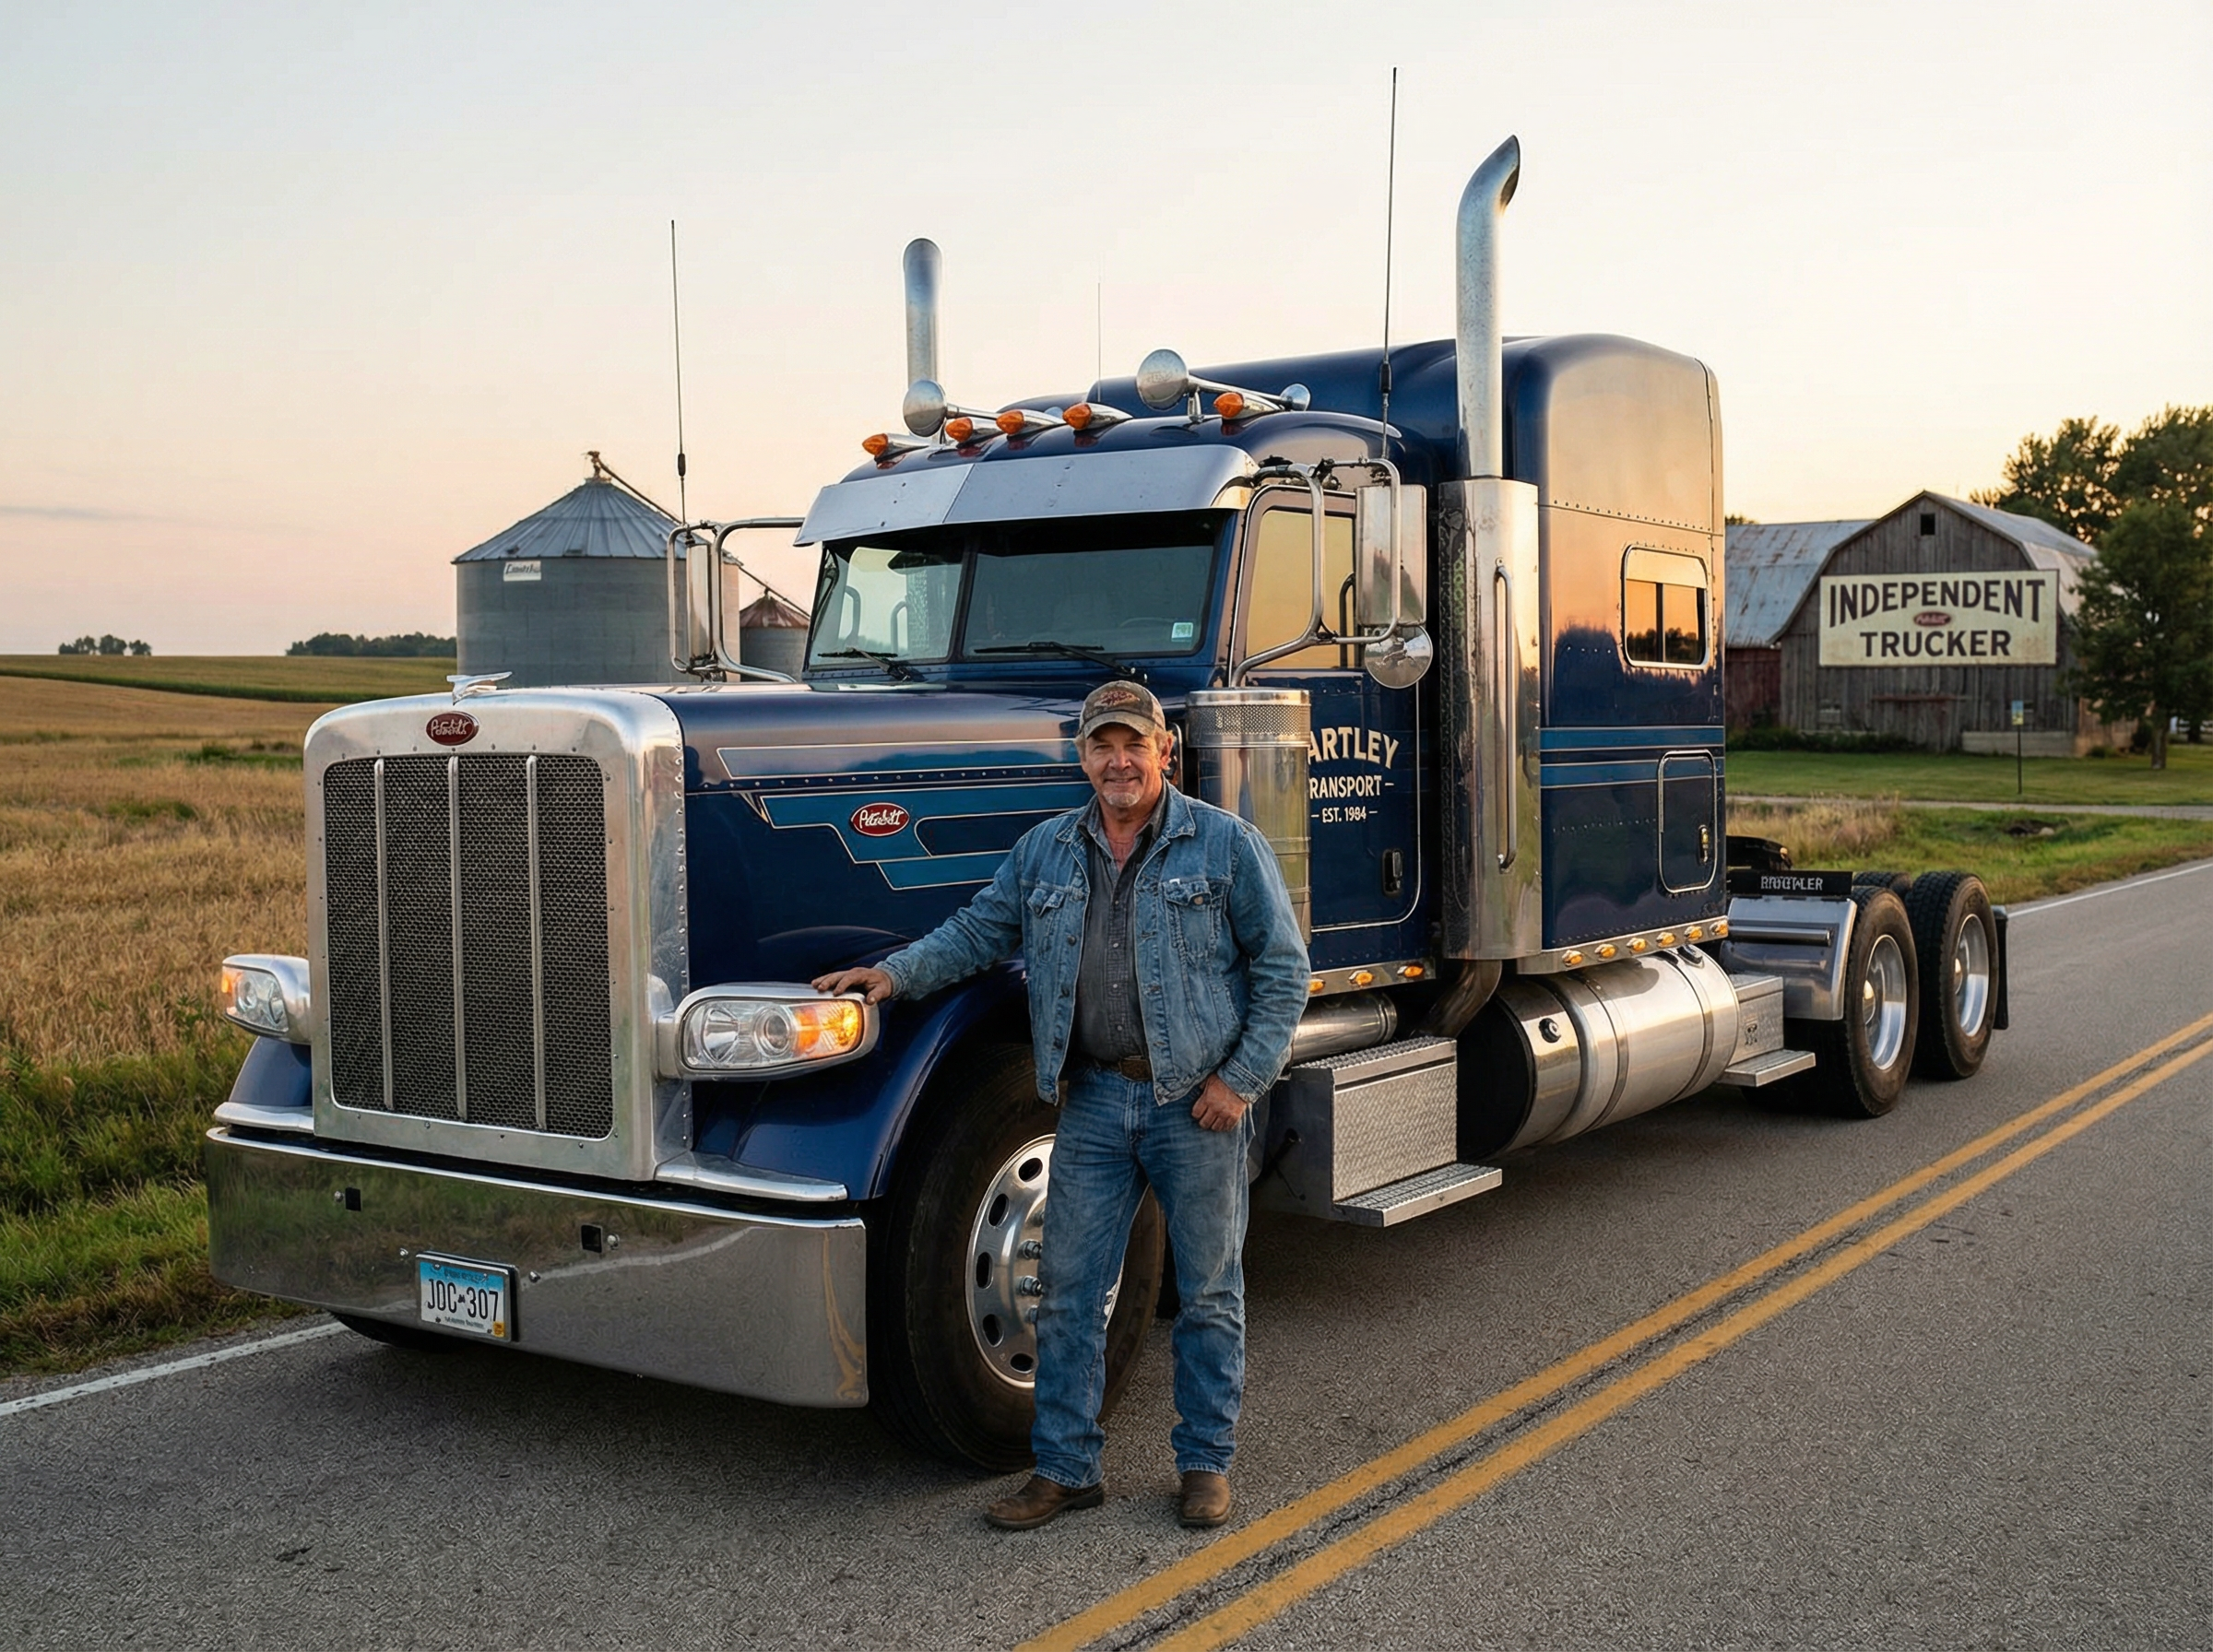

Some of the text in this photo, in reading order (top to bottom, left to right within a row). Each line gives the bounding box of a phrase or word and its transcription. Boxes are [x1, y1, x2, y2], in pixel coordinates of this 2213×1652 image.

[1829, 579, 2045, 628] INDEPENDENT
[1860, 630, 2011, 657] TRUCKER
[1308, 726, 1399, 769] ARTLEY
[1308, 775, 1382, 799] RANSPORT
[1321, 807, 1343, 823] EST.
